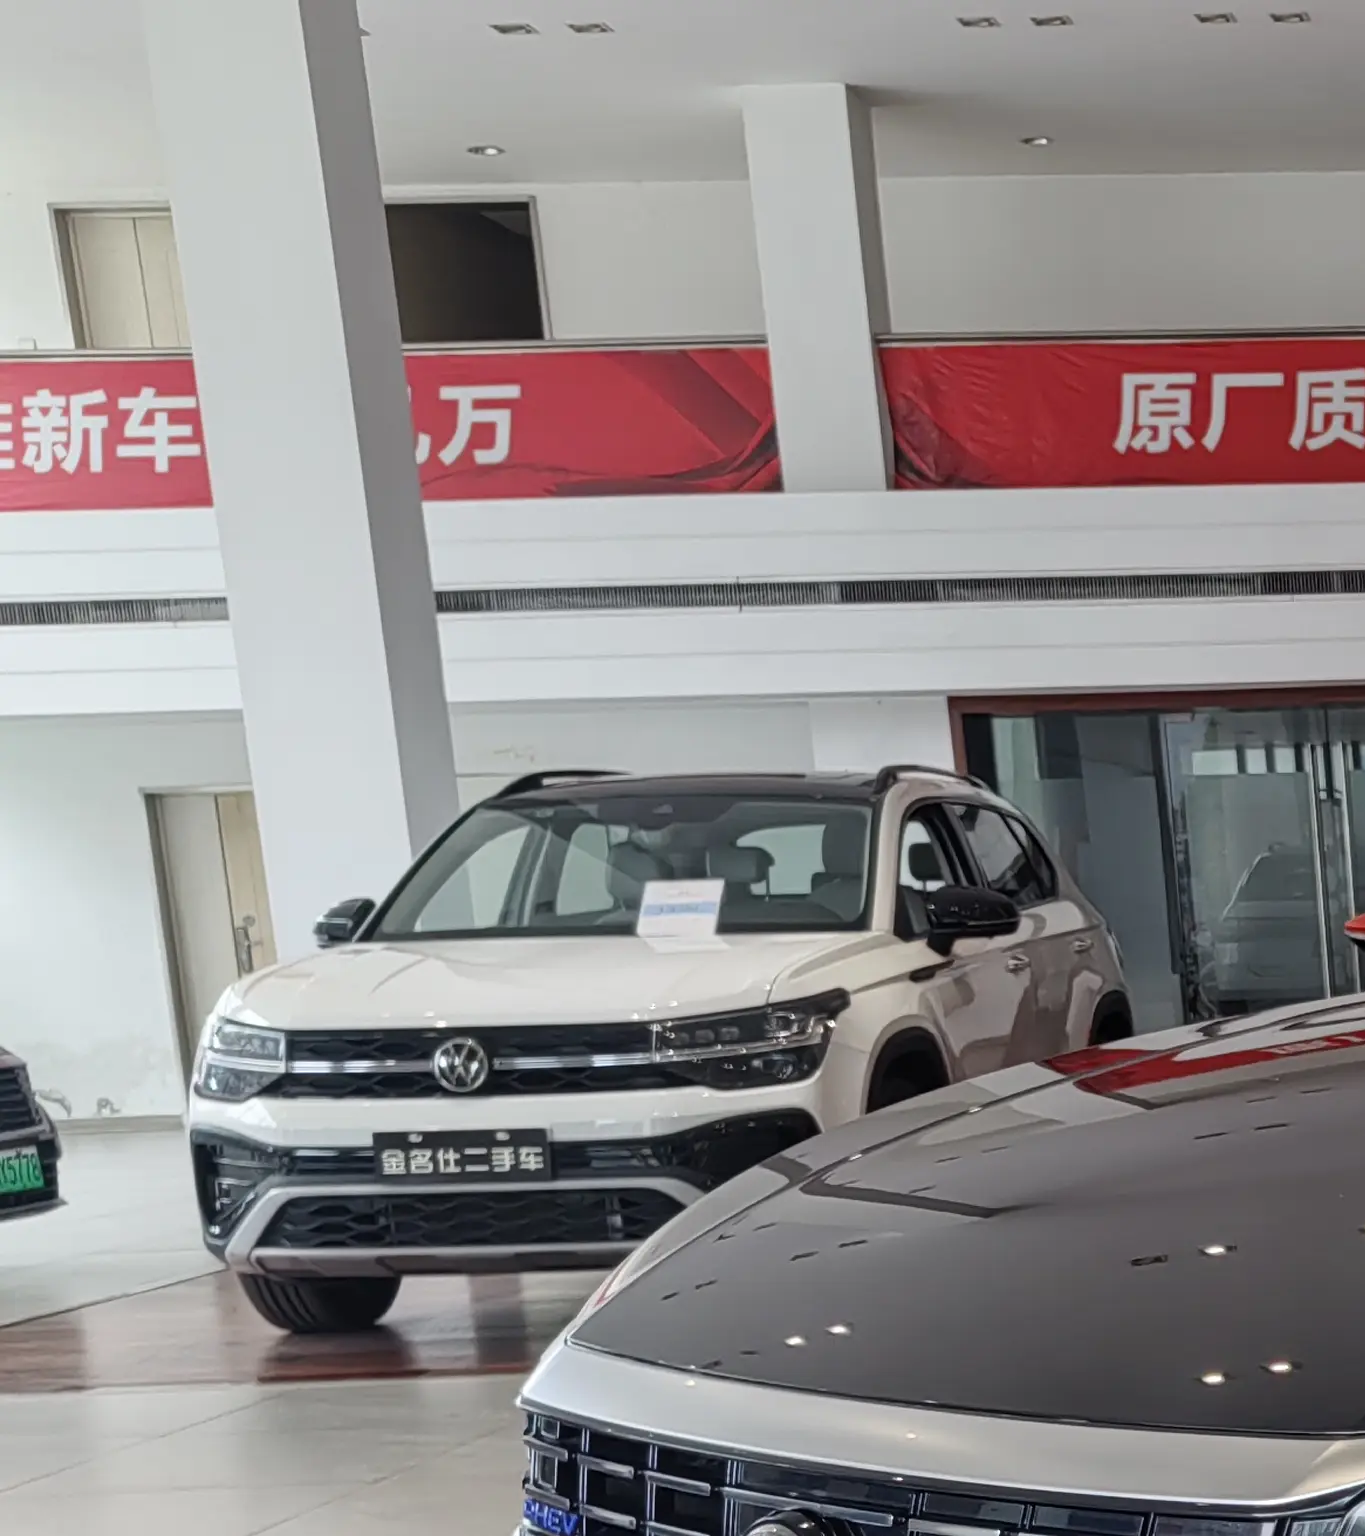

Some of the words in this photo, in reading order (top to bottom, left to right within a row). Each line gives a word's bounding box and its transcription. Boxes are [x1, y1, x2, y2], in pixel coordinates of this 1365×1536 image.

[0, 386, 202, 474] 新车
[407, 383, 521, 467] 万
[380, 1146, 545, 1176] 金名仕二手车
